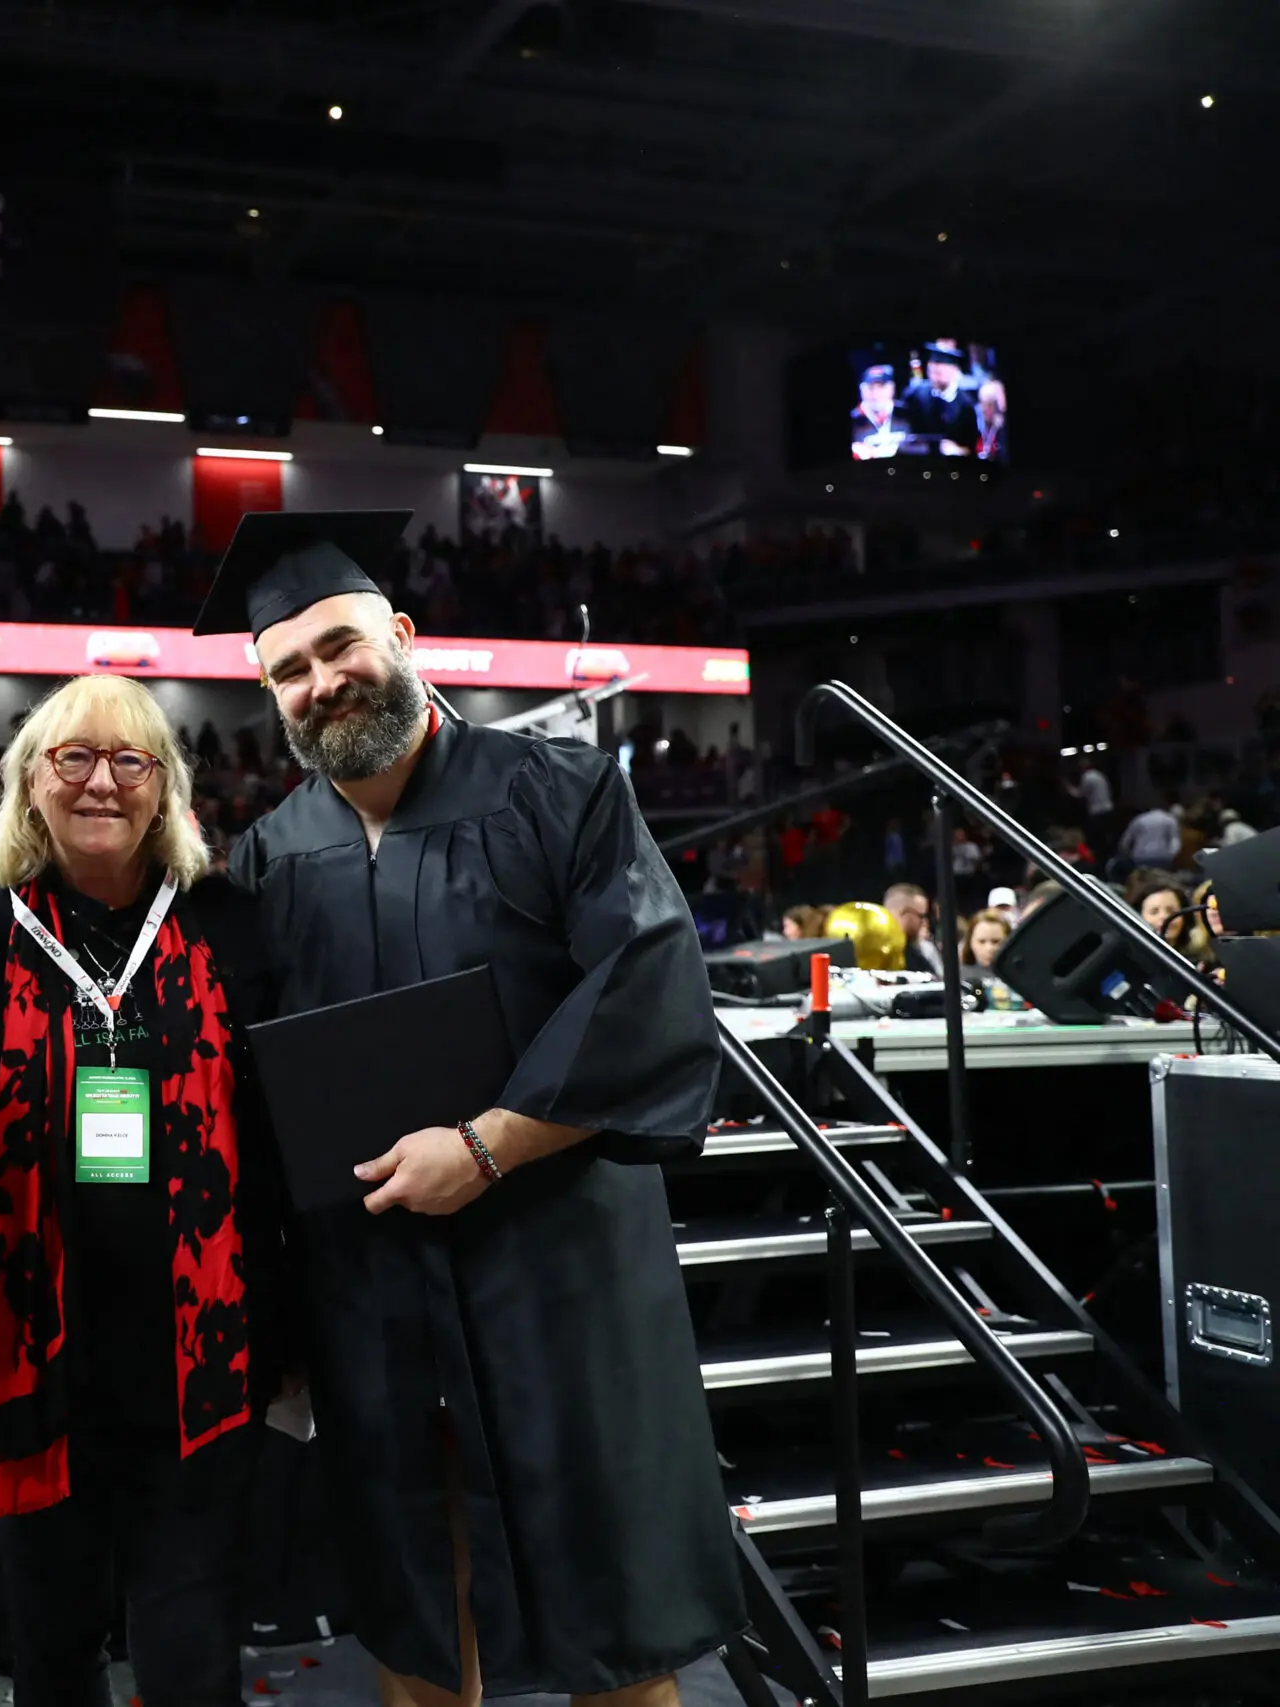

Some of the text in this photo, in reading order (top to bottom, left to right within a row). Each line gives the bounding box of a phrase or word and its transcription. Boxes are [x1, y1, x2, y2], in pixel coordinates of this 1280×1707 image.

[30, 925, 62, 958] CINCINNATI
[74, 1033, 91, 1047] LL
[129, 1024, 150, 1041] FA
